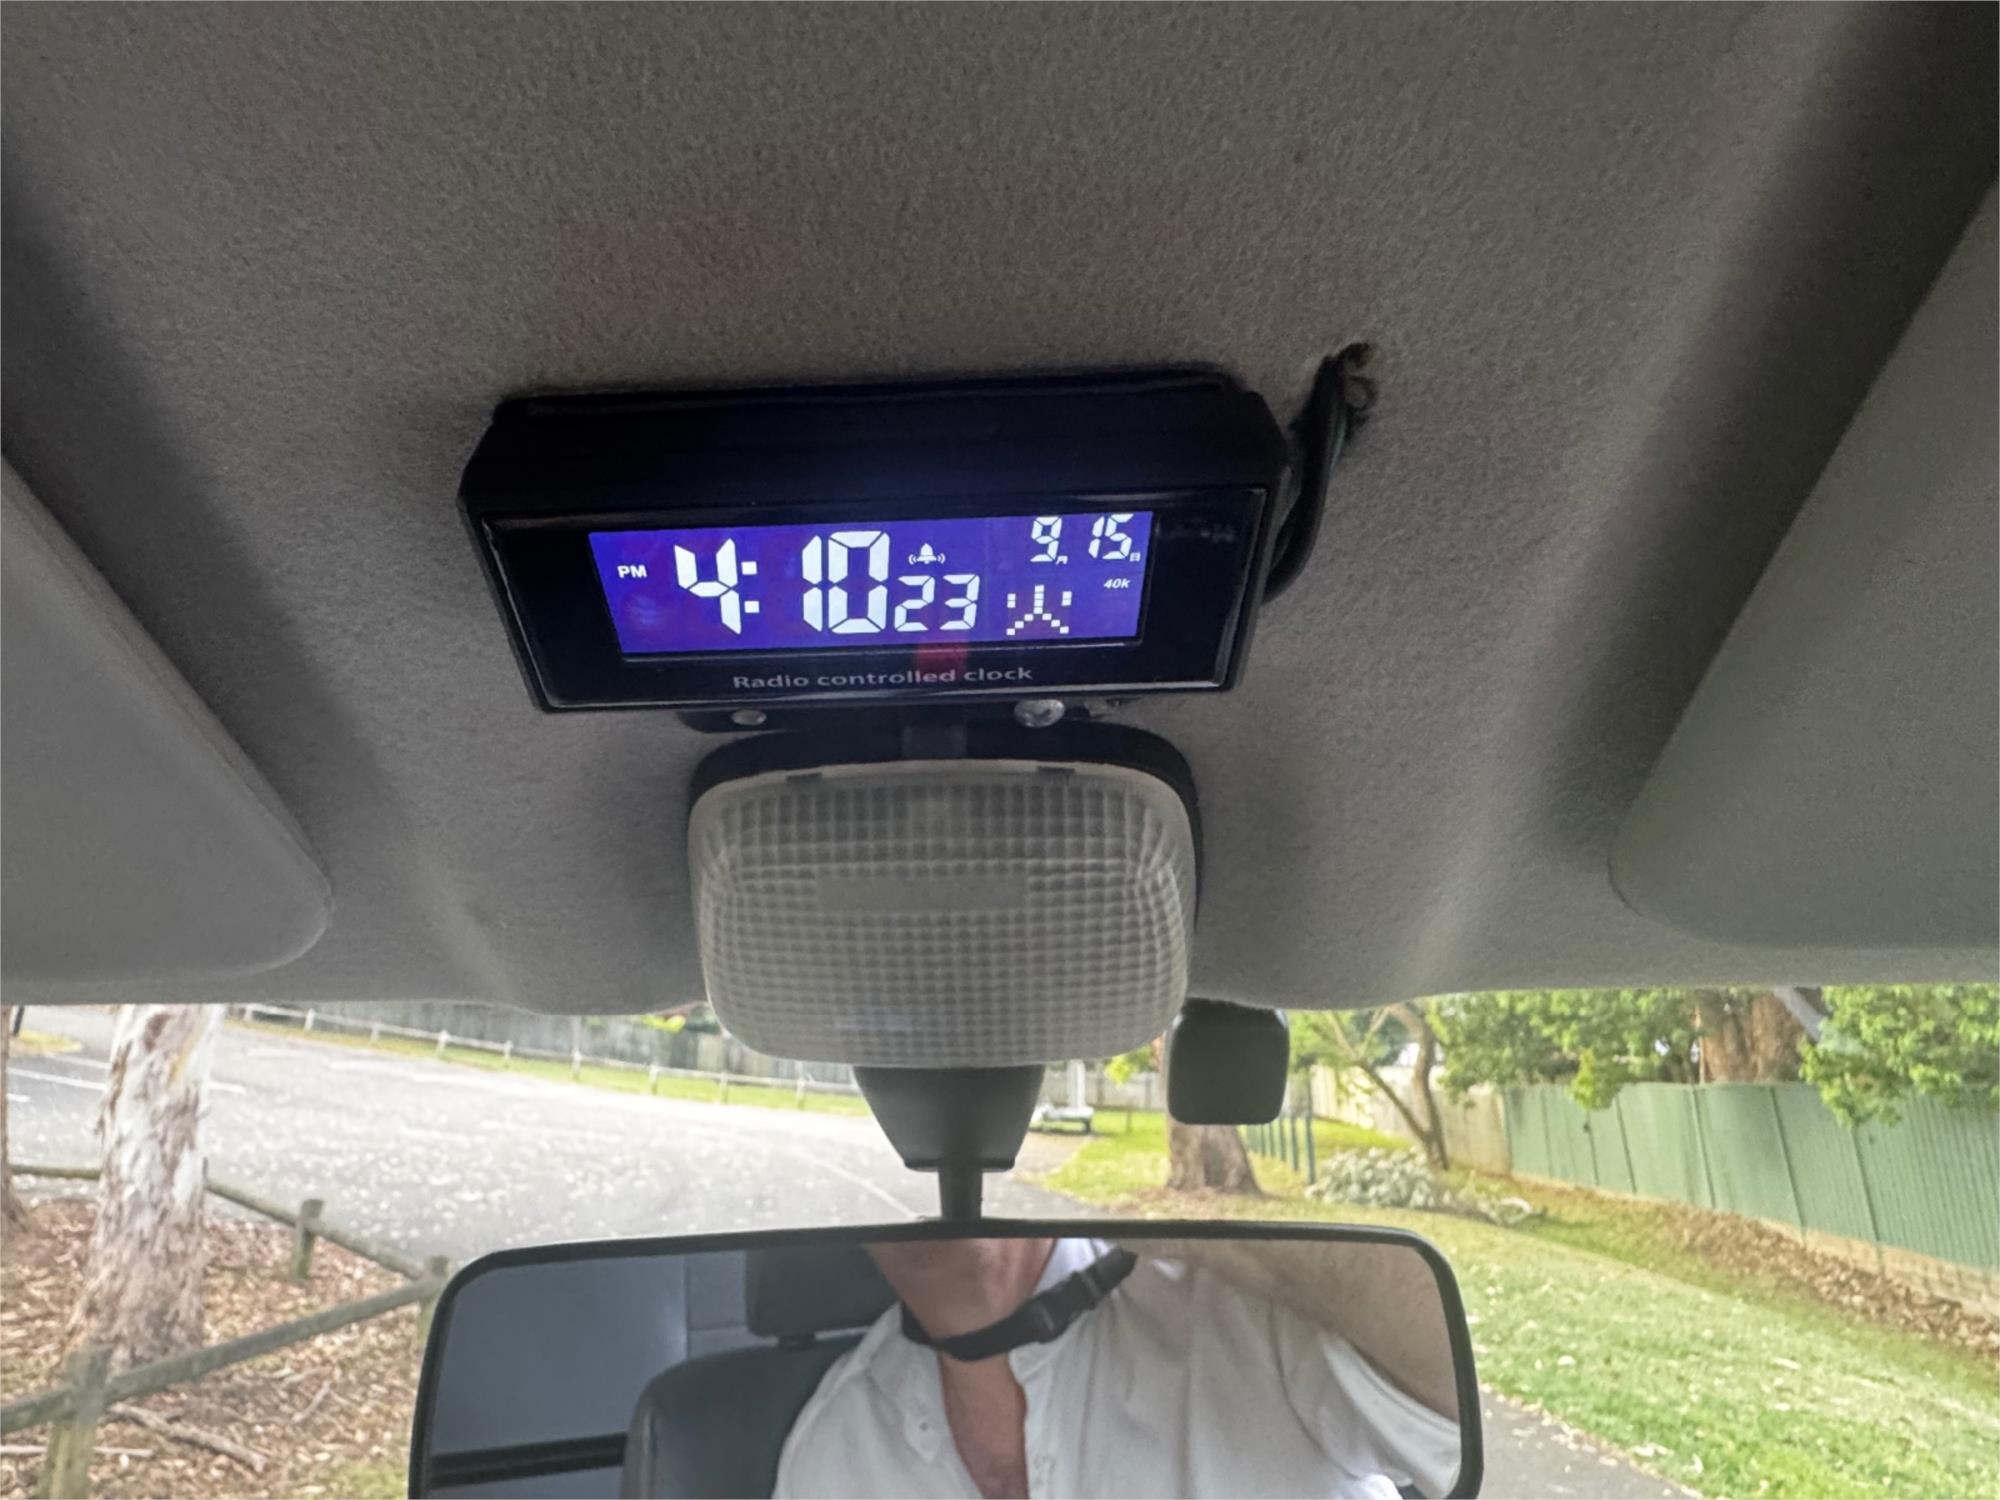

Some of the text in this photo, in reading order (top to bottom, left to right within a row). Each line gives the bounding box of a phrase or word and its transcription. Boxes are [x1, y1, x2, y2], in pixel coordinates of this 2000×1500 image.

[1103, 578, 1131, 589] 40k
[617, 564, 648, 578] PM
[893, 573, 981, 632] 23
[733, 667, 1033, 689] Radio controlled clock
